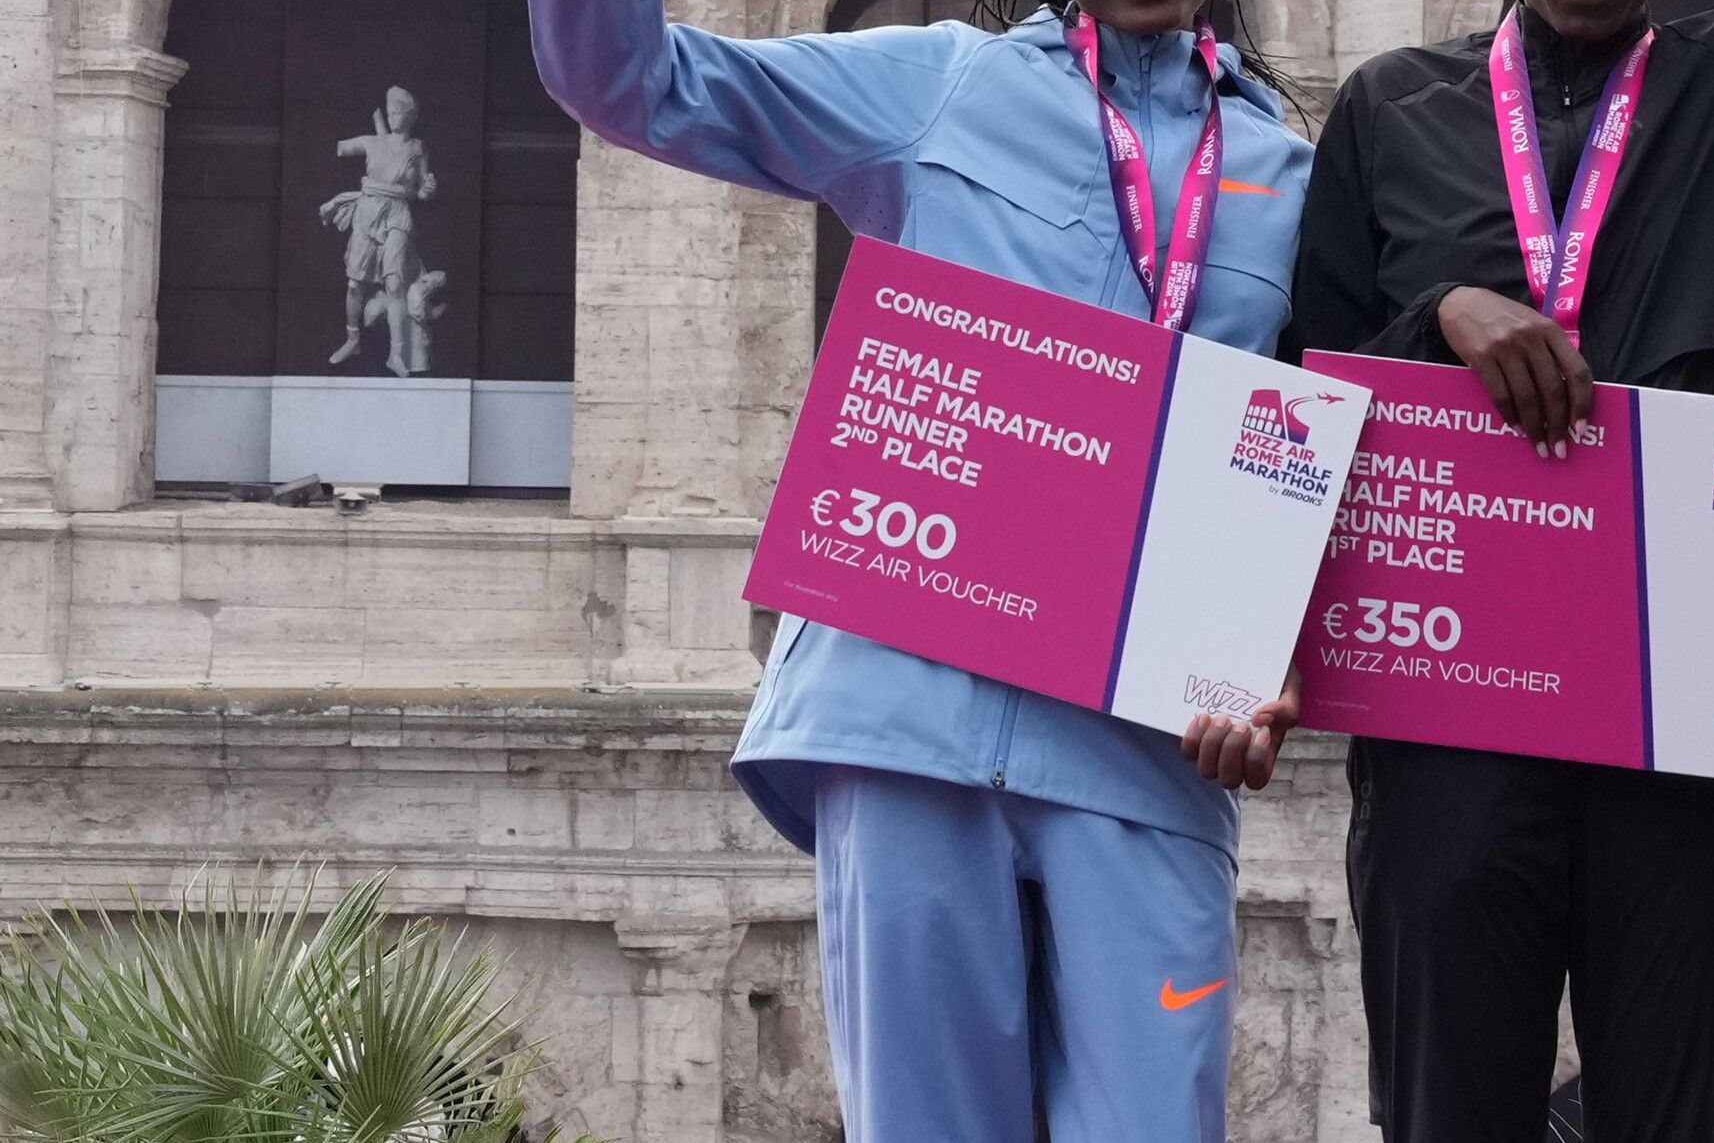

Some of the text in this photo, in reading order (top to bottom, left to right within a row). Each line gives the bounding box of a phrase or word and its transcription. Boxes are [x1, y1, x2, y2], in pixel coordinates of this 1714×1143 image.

[1508, 106, 1529, 154] ROMA
[1126, 185, 1142, 233] FINISHER
[1522, 173, 1538, 214] FINISHER
[1581, 170, 1600, 210] FINISHER
[1187, 195, 1203, 239] FINISHER
[1558, 232, 1584, 287] ROMA
[1178, 262, 1193, 310] MARATHON
[876, 287, 1141, 384] CONGRATULATIONS!
[857, 338, 981, 394] FEMALE
[840, 393, 968, 452] RUNNER
[848, 365, 1111, 465] HALF MARATHON
[882, 437, 982, 487] PLACE
[1234, 443, 1332, 481] ROME HALF
[1240, 430, 1316, 463] WIZZ AIR
[1351, 451, 1454, 486] EMALE
[1230, 456, 1328, 496] MARATHON
[1281, 488, 1324, 506] BROOKS
[1332, 507, 1456, 543] RUNNER
[1419, 488, 1595, 531] MARATHON
[800, 530, 1038, 621] WIZZ AIR VOUCHER
[1367, 540, 1465, 574] PLACE
[1319, 646, 1561, 694] WIZZ AIR VOUCHER
